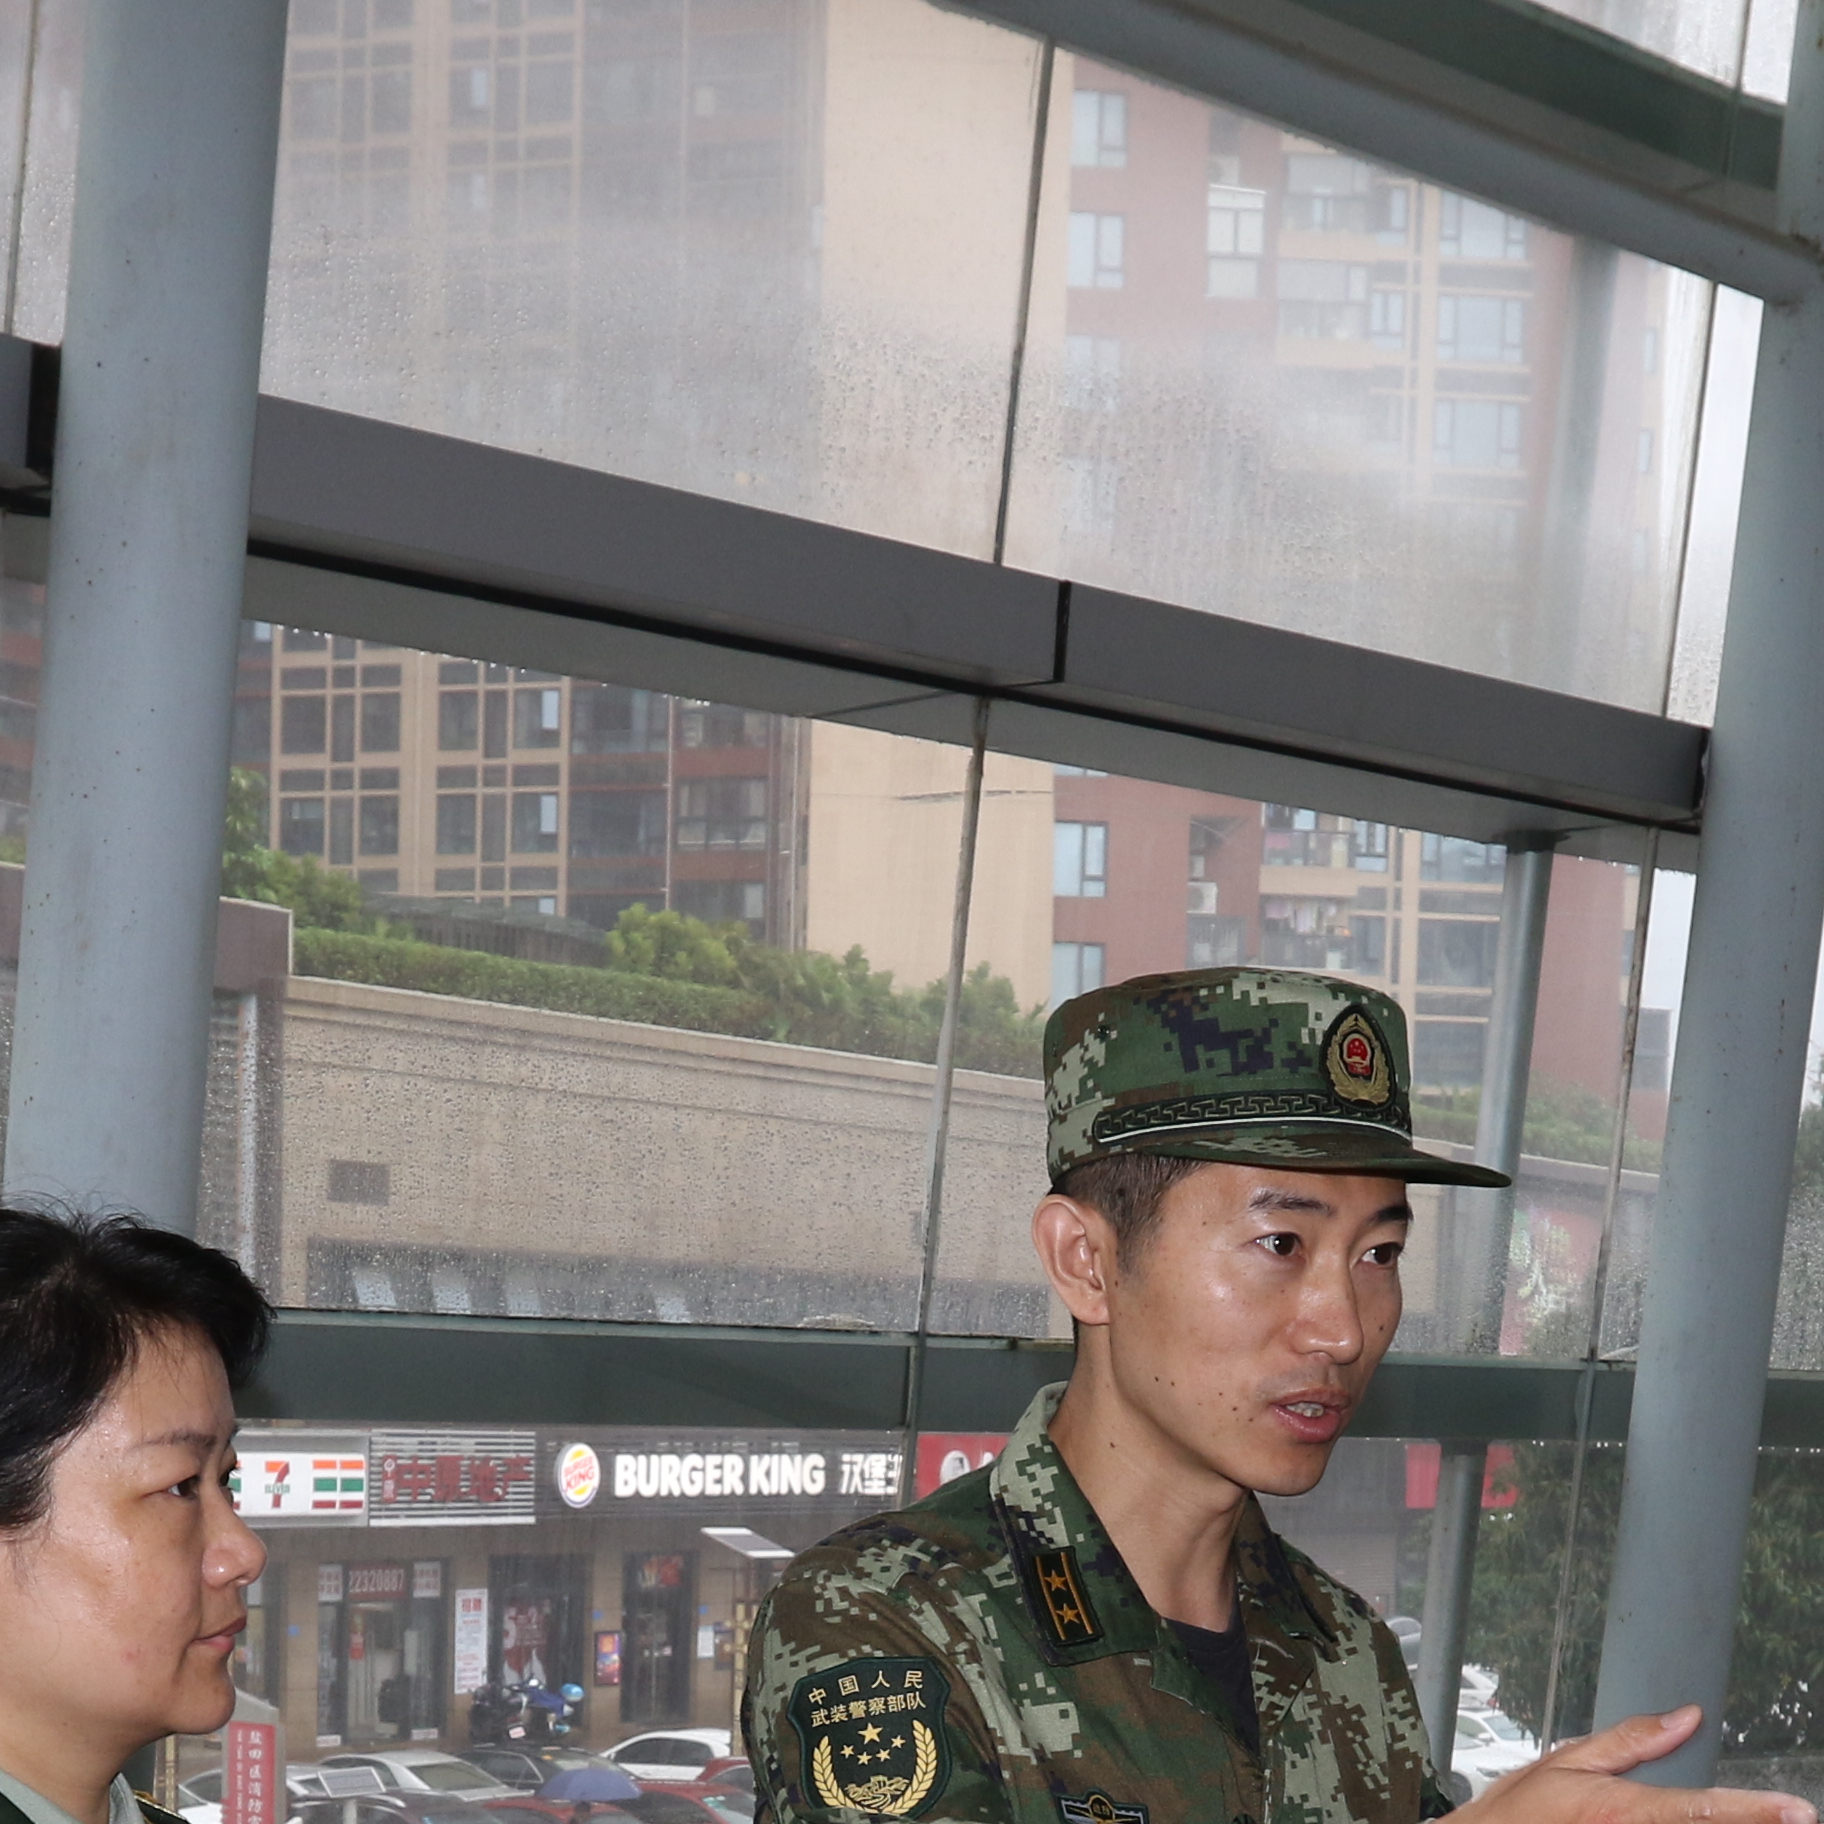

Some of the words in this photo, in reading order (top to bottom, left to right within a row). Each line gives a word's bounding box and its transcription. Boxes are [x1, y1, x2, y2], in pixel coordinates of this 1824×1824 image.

[265, 1461, 289, 1508] 7
[565, 1466, 594, 1490] KING
[614, 1454, 744, 1497] BURGER
[749, 1454, 826, 1496] KING
[808, 1670, 924, 1705] 中国人民
[810, 1691, 926, 1728] 武装警察部队
